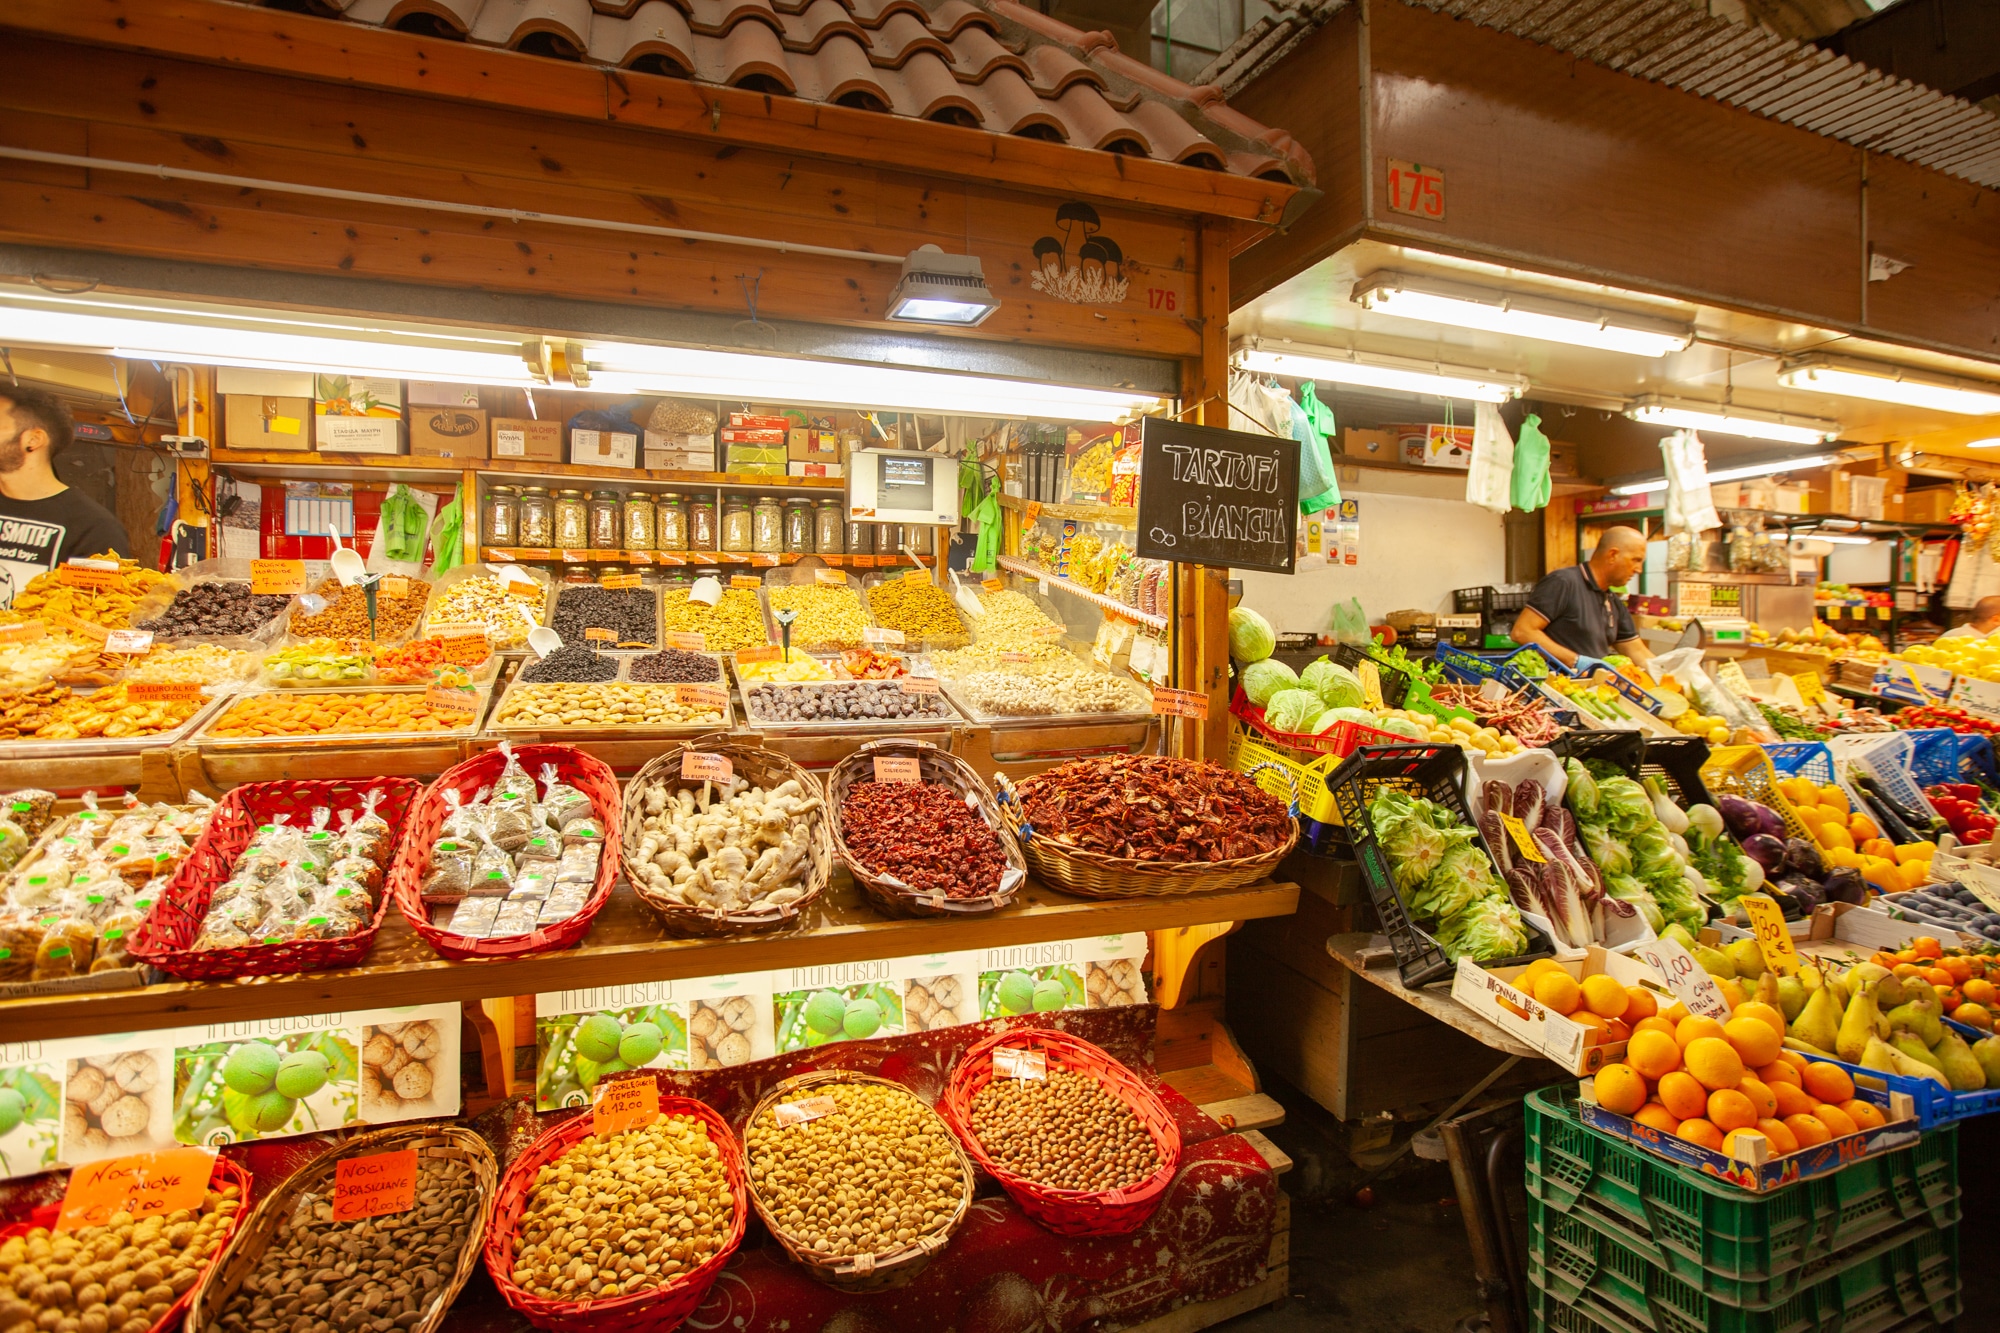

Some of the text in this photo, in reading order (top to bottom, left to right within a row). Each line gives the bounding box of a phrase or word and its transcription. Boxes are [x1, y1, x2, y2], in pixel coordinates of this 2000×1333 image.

[1388, 168, 1443, 216] 175
[1147, 287, 1176, 312] 176
[454, 420, 474, 433] Spray
[539, 426, 558, 435] CHIPS
[1162, 444, 1281, 495] TARTUFI
[1182, 494, 1287, 544] BIANCHI
[91, 568, 122, 576] NATURALE
[253, 560, 287, 568] PRUGNE
[699, 688, 729, 699] MOSCIONI
[1155, 687, 1208, 700] POMODORI SECCHI
[1177, 699, 1207, 710] RACCOLTO
[988, 941, 1073, 969] in un guscio
[792, 959, 890, 988] in un guscio
[611, 980, 673, 1008] guscio
[1487, 976, 1518, 1005] MONNA
[1688, 995, 1715, 1014] ITALIA
[608, 1090, 641, 1101] TENERO
[611, 1101, 643, 1114] 12.00
[1631, 1121, 1661, 1143] MG
[1836, 1135, 1867, 1163] MG
[87, 1160, 143, 1187] NOCI
[342, 1163, 384, 1178] NOCI
[128, 1175, 182, 1194] NUOVE
[82, 1204, 103, 1222] €
[338, 1201, 354, 1214] €
